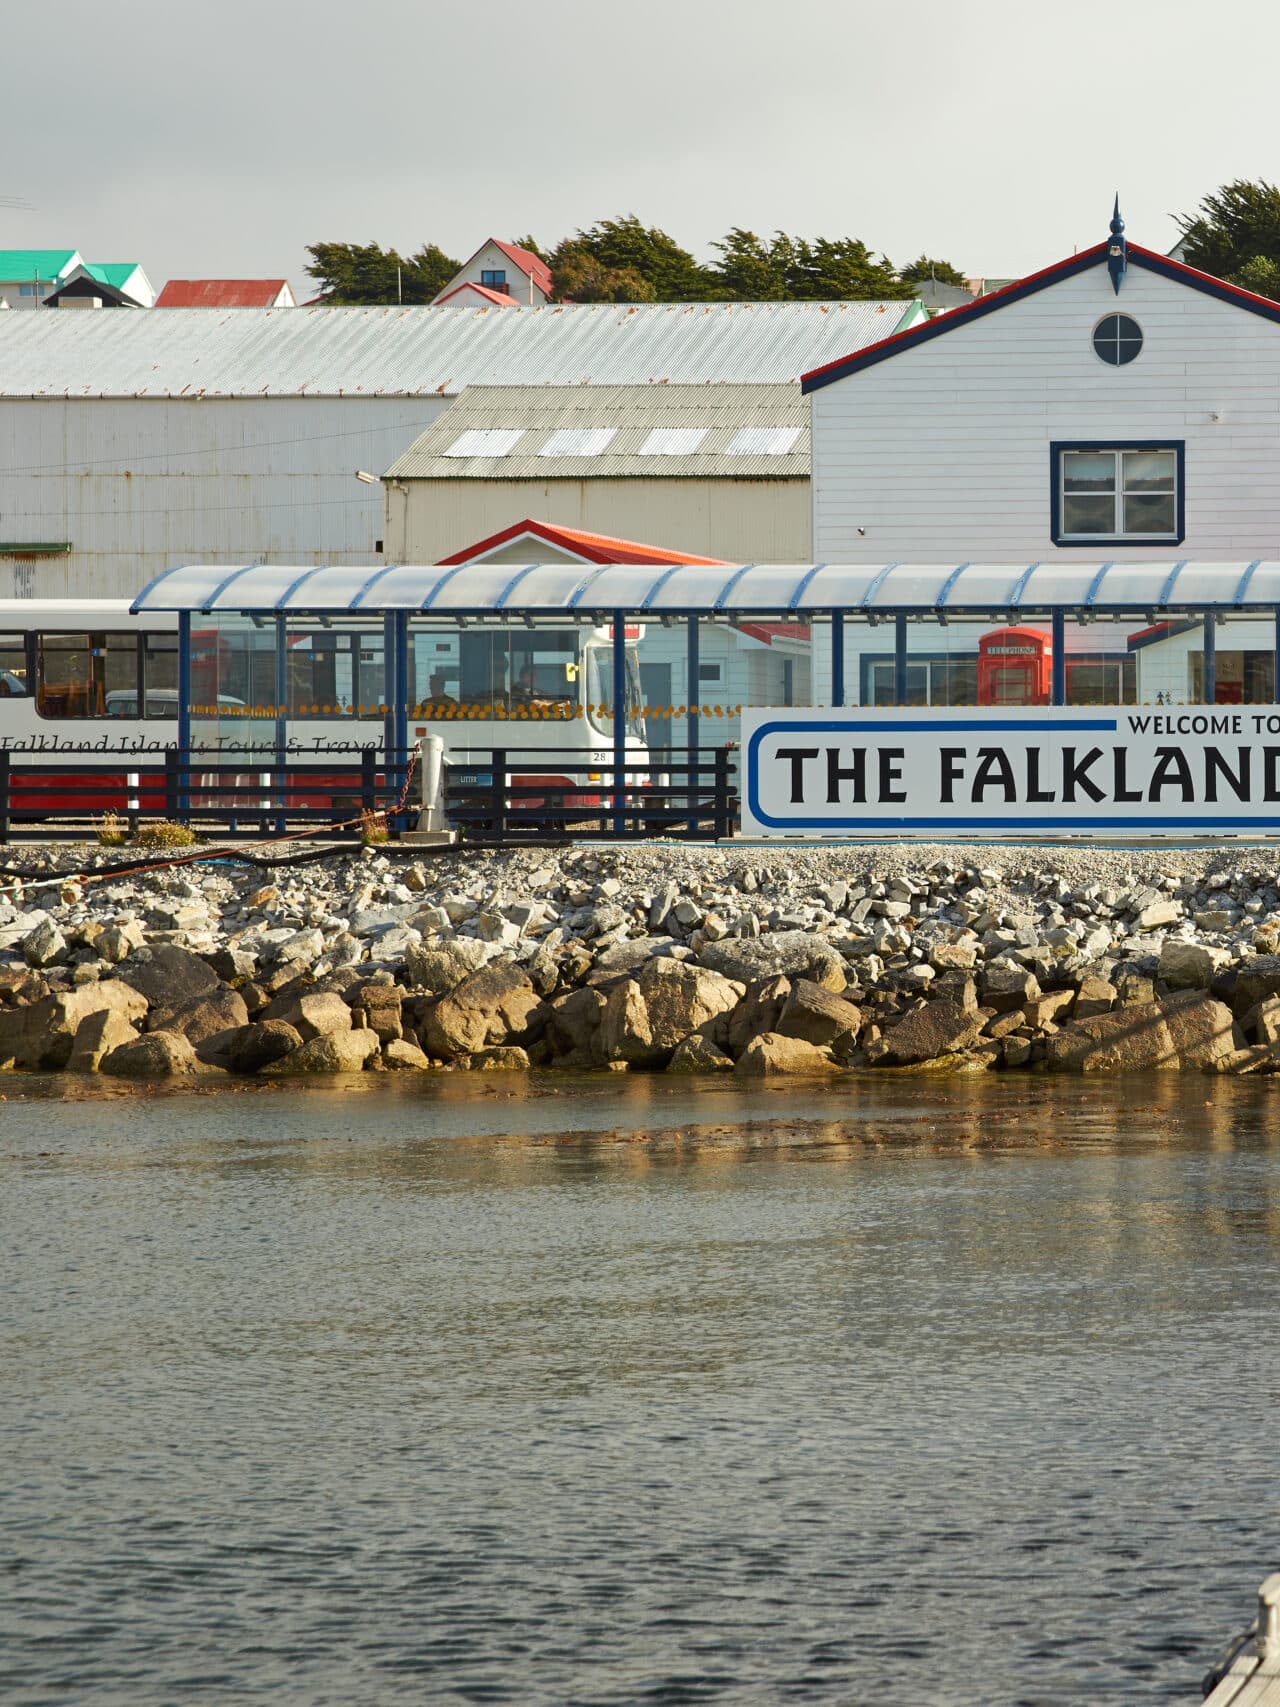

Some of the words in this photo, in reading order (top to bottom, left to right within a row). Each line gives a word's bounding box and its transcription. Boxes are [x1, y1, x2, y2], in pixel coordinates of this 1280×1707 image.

[1128, 716, 1242, 735] WELCOME
[1, 735, 114, 753] Falkland
[215, 736, 278, 756] Tours
[312, 735, 385, 754] Travel
[593, 753, 606, 762] 28
[460, 775, 477, 783] LITTER
[775, 748, 907, 803] THE
